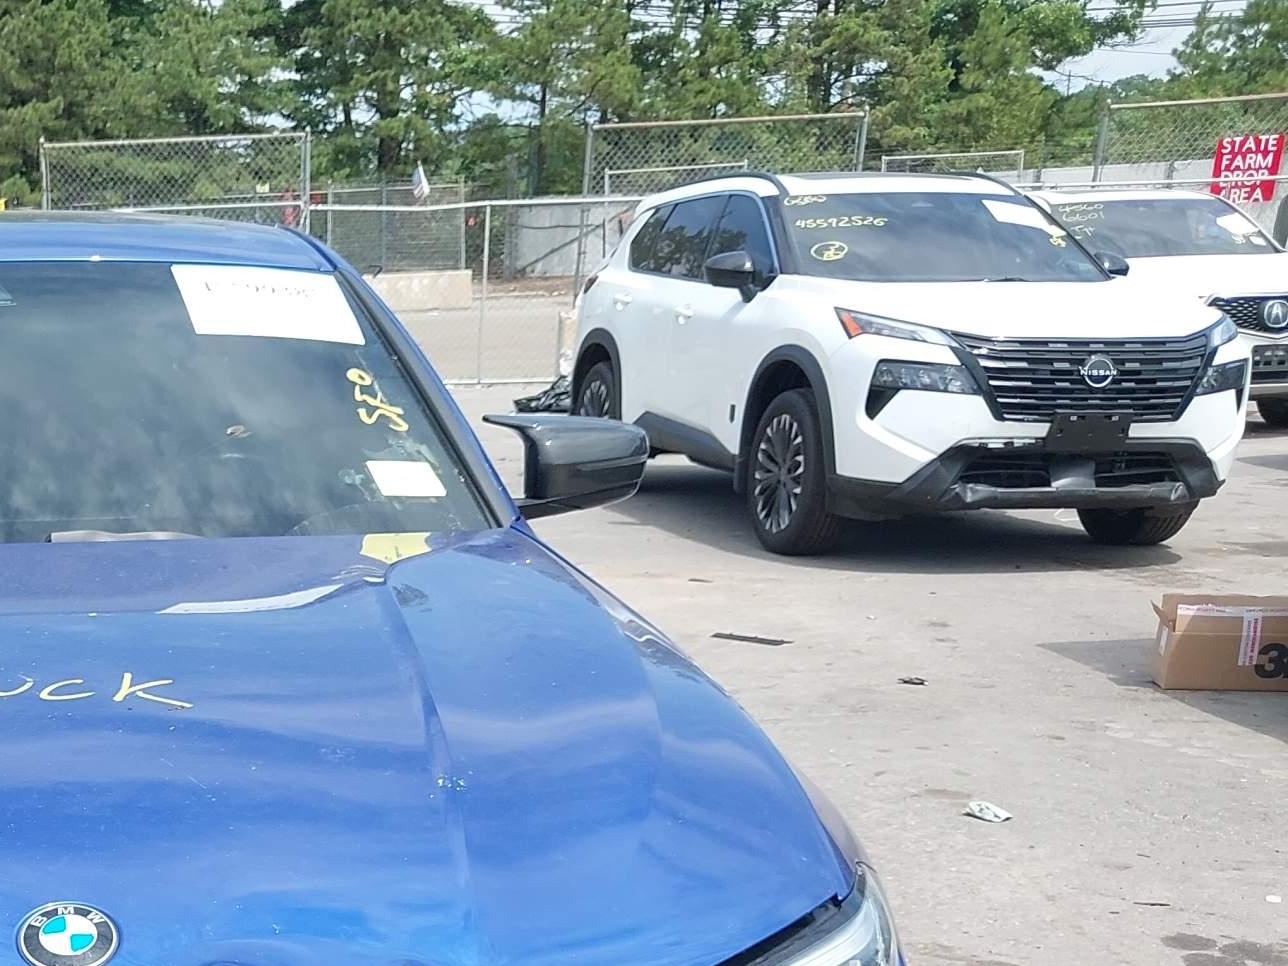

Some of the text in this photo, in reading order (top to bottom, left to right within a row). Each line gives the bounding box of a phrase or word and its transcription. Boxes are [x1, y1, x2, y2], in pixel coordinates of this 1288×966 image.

[1220, 134, 1280, 154] STATE
[1220, 152, 1274, 171] FARM
[1219, 169, 1269, 188] DROP
[1078, 366, 1117, 376] NISSAN
[30, 906, 105, 928] BMW
